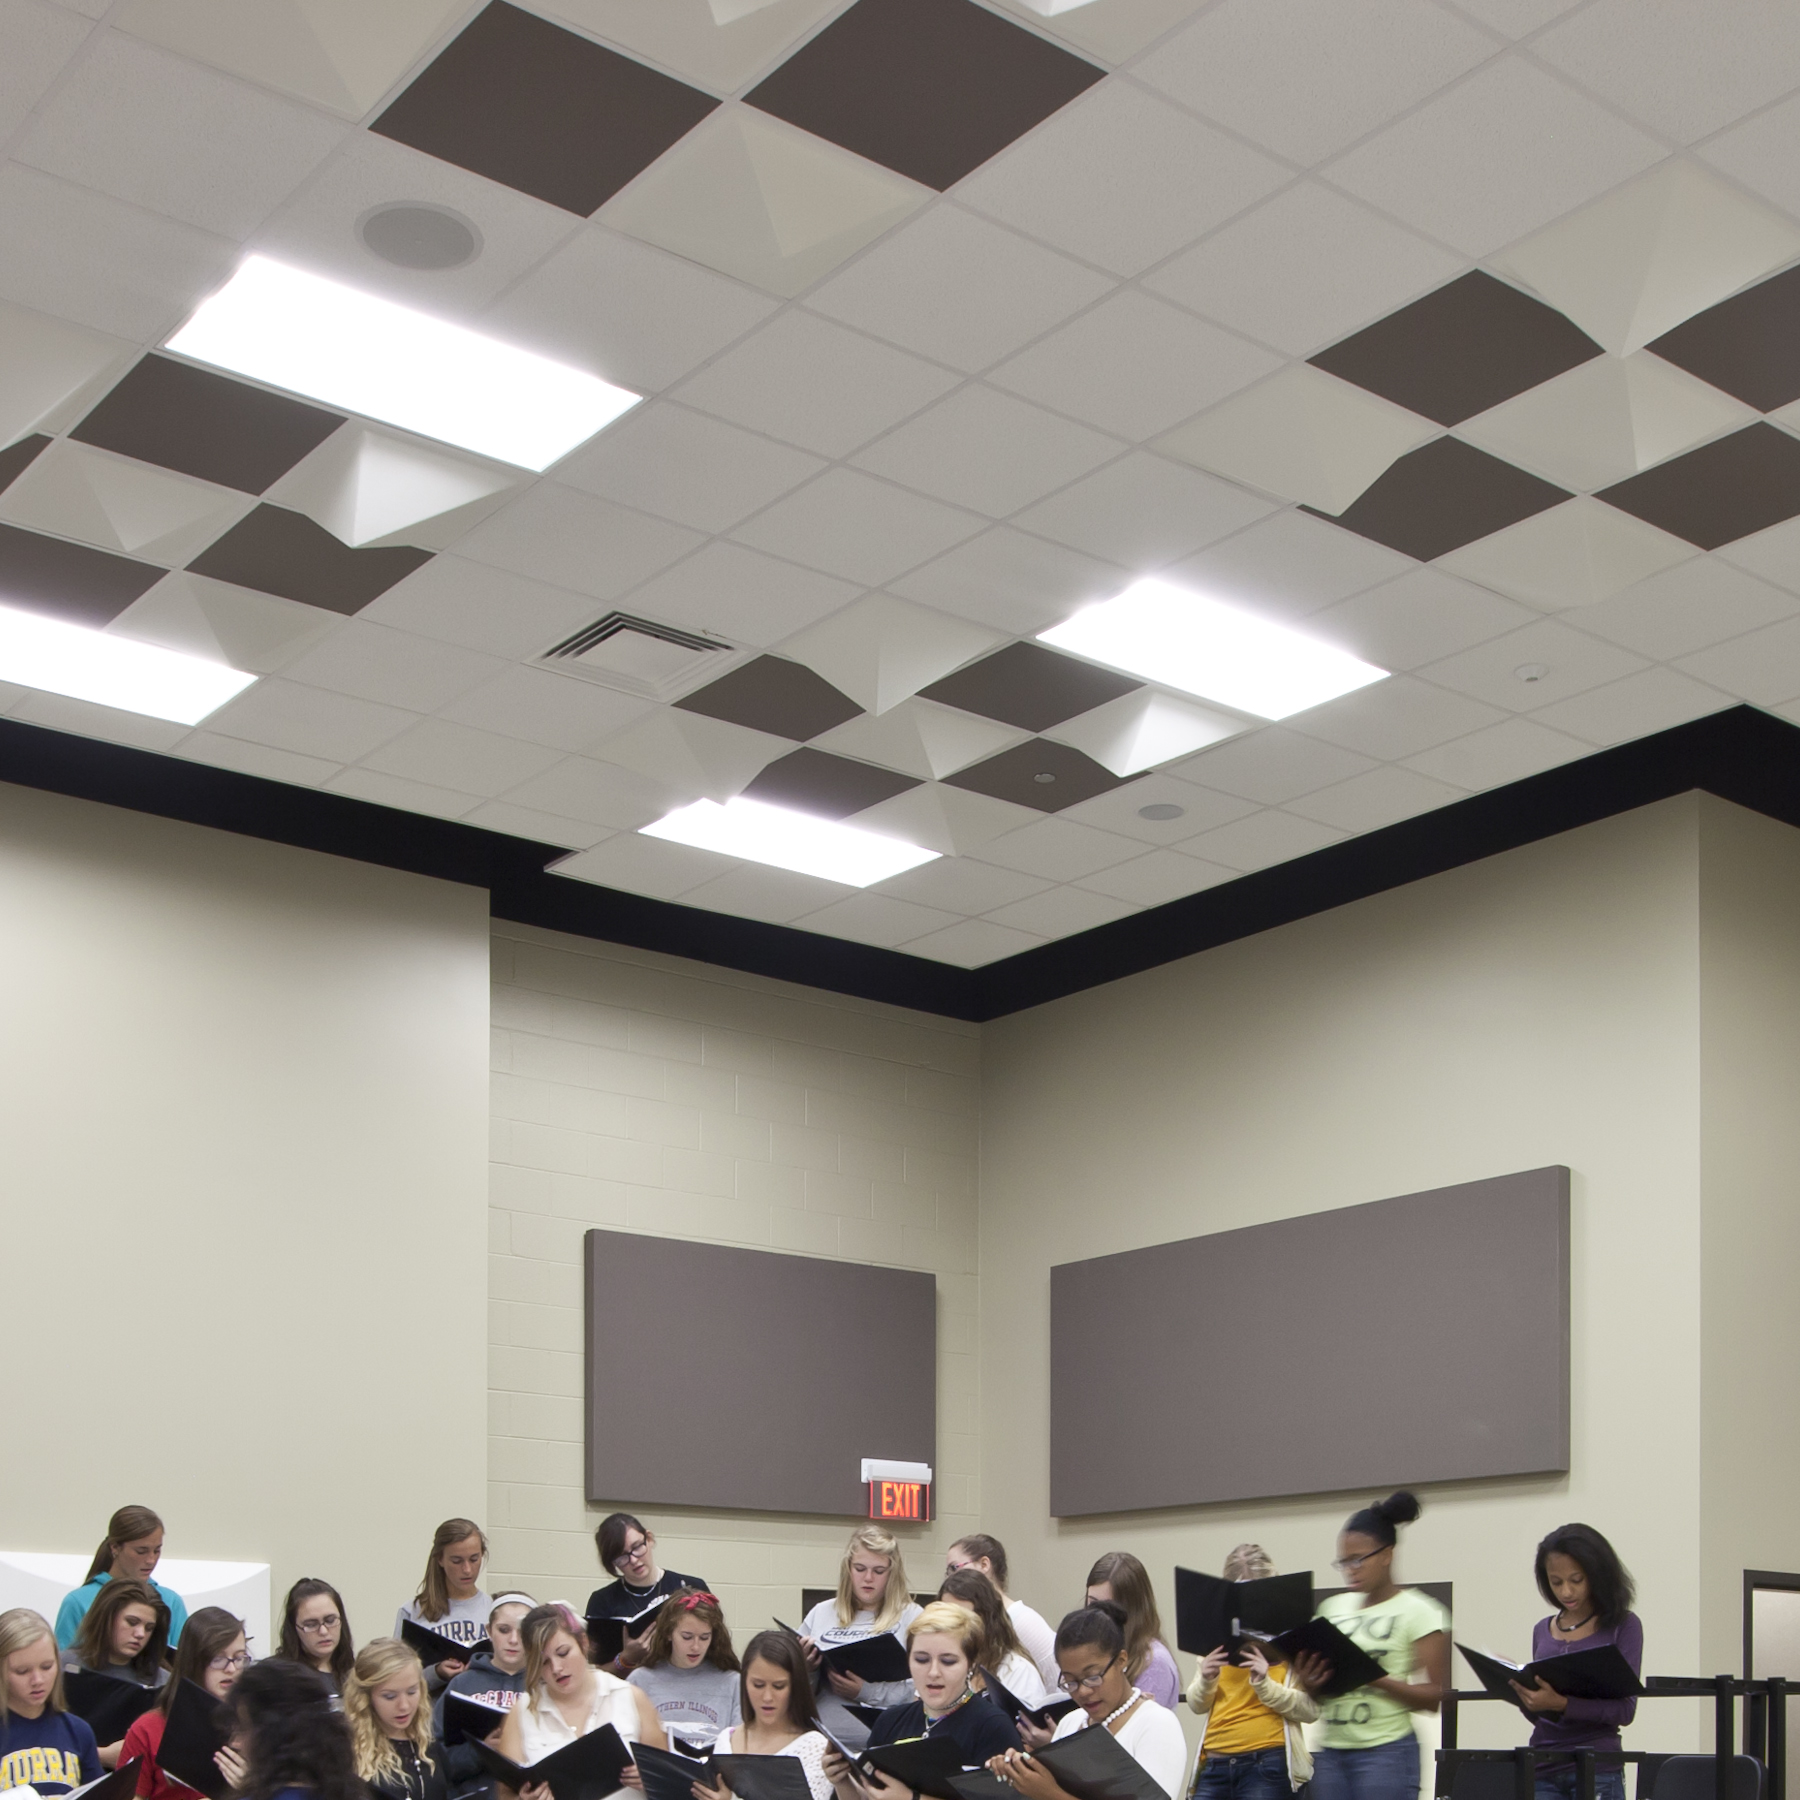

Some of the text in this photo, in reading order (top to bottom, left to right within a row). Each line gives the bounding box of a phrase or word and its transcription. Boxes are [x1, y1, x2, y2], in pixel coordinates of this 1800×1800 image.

[882, 1482, 921, 1518] EXIT
[431, 1620, 488, 1642] URRA
[656, 1701, 686, 1713] THERN
